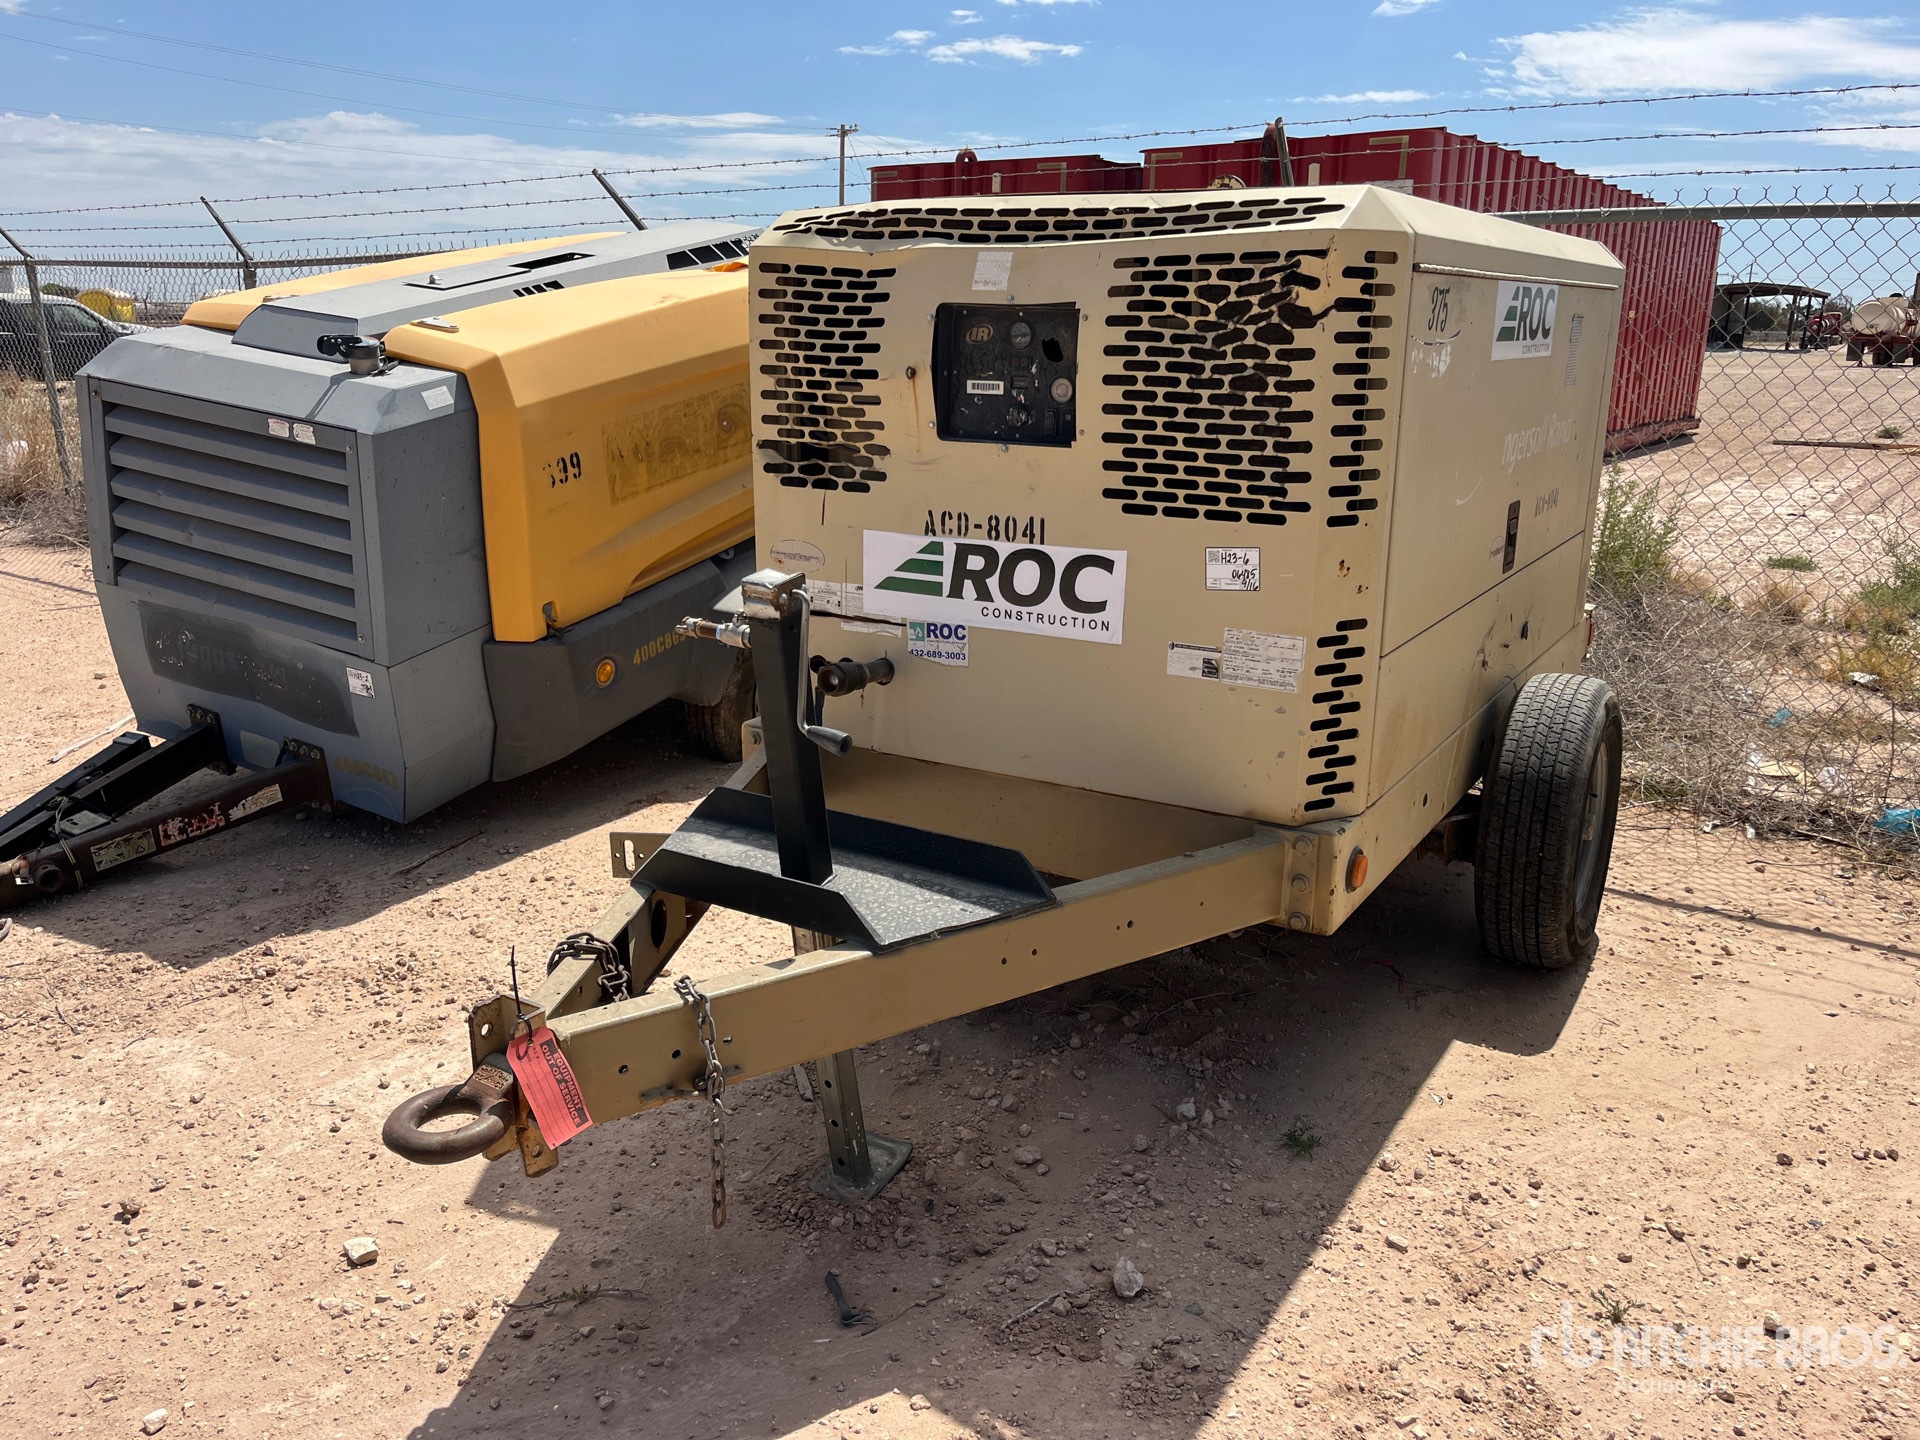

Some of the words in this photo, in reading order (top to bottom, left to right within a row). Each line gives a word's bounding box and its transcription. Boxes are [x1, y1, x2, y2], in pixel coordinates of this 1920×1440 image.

[1428, 286, 1451, 332] 375
[1515, 286, 1556, 341] ROC
[924, 509, 1046, 545] ACD-8041
[945, 541, 1116, 614] ROC
[1220, 551, 1250, 566] H23-6
[926, 622, 967, 641] ROC
[981, 606, 1111, 632] CONSTRUCTION
[910, 648, 966, 661] 432-689-3003
[542, 1044, 555, 1069] OUT
[551, 1066, 562, 1083] OF
[558, 1082, 582, 1126] SERVICE
[553, 1051, 583, 1110] EQUIPMENT
